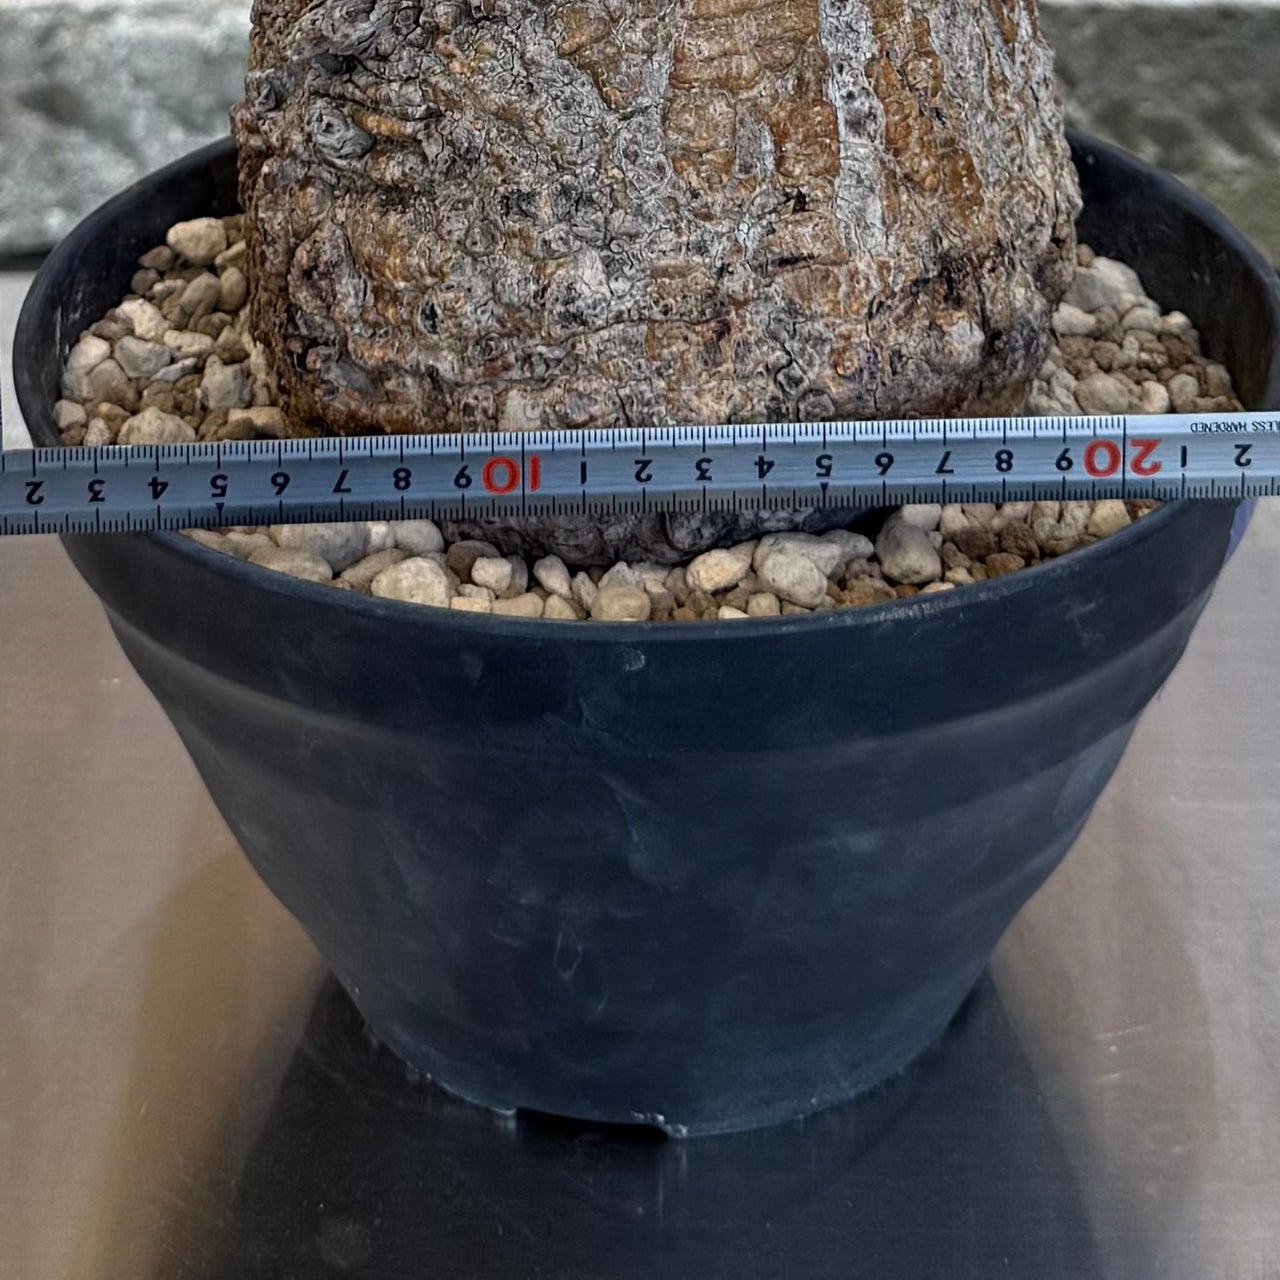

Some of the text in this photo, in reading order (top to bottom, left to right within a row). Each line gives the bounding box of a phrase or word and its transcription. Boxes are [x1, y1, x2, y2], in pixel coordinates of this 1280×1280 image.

[1190, 421, 1245, 434] HARDENED
[815, 454, 832, 477] 5
[875, 452, 894, 475] 6
[936, 451, 955, 474] 7
[995, 449, 1015, 472] 8
[1055, 447, 1074, 471] 9
[1083, 439, 1162, 477] 20
[1234, 444, 1253, 467] 2
[393, 468, 412, 490] 8
[454, 465, 472, 488] 9
[482, 455, 540, 495] 10
[634, 459, 654, 483] 2
[695, 458, 713, 481] 3
[754, 456, 775, 479] 4
[25, 481, 44, 504] 2
[88, 479, 106, 503] 3
[148, 477, 168, 499] 4
[211, 475, 228, 497] 5
[271, 472, 291, 494] 6
[332, 470, 352, 492] 7
